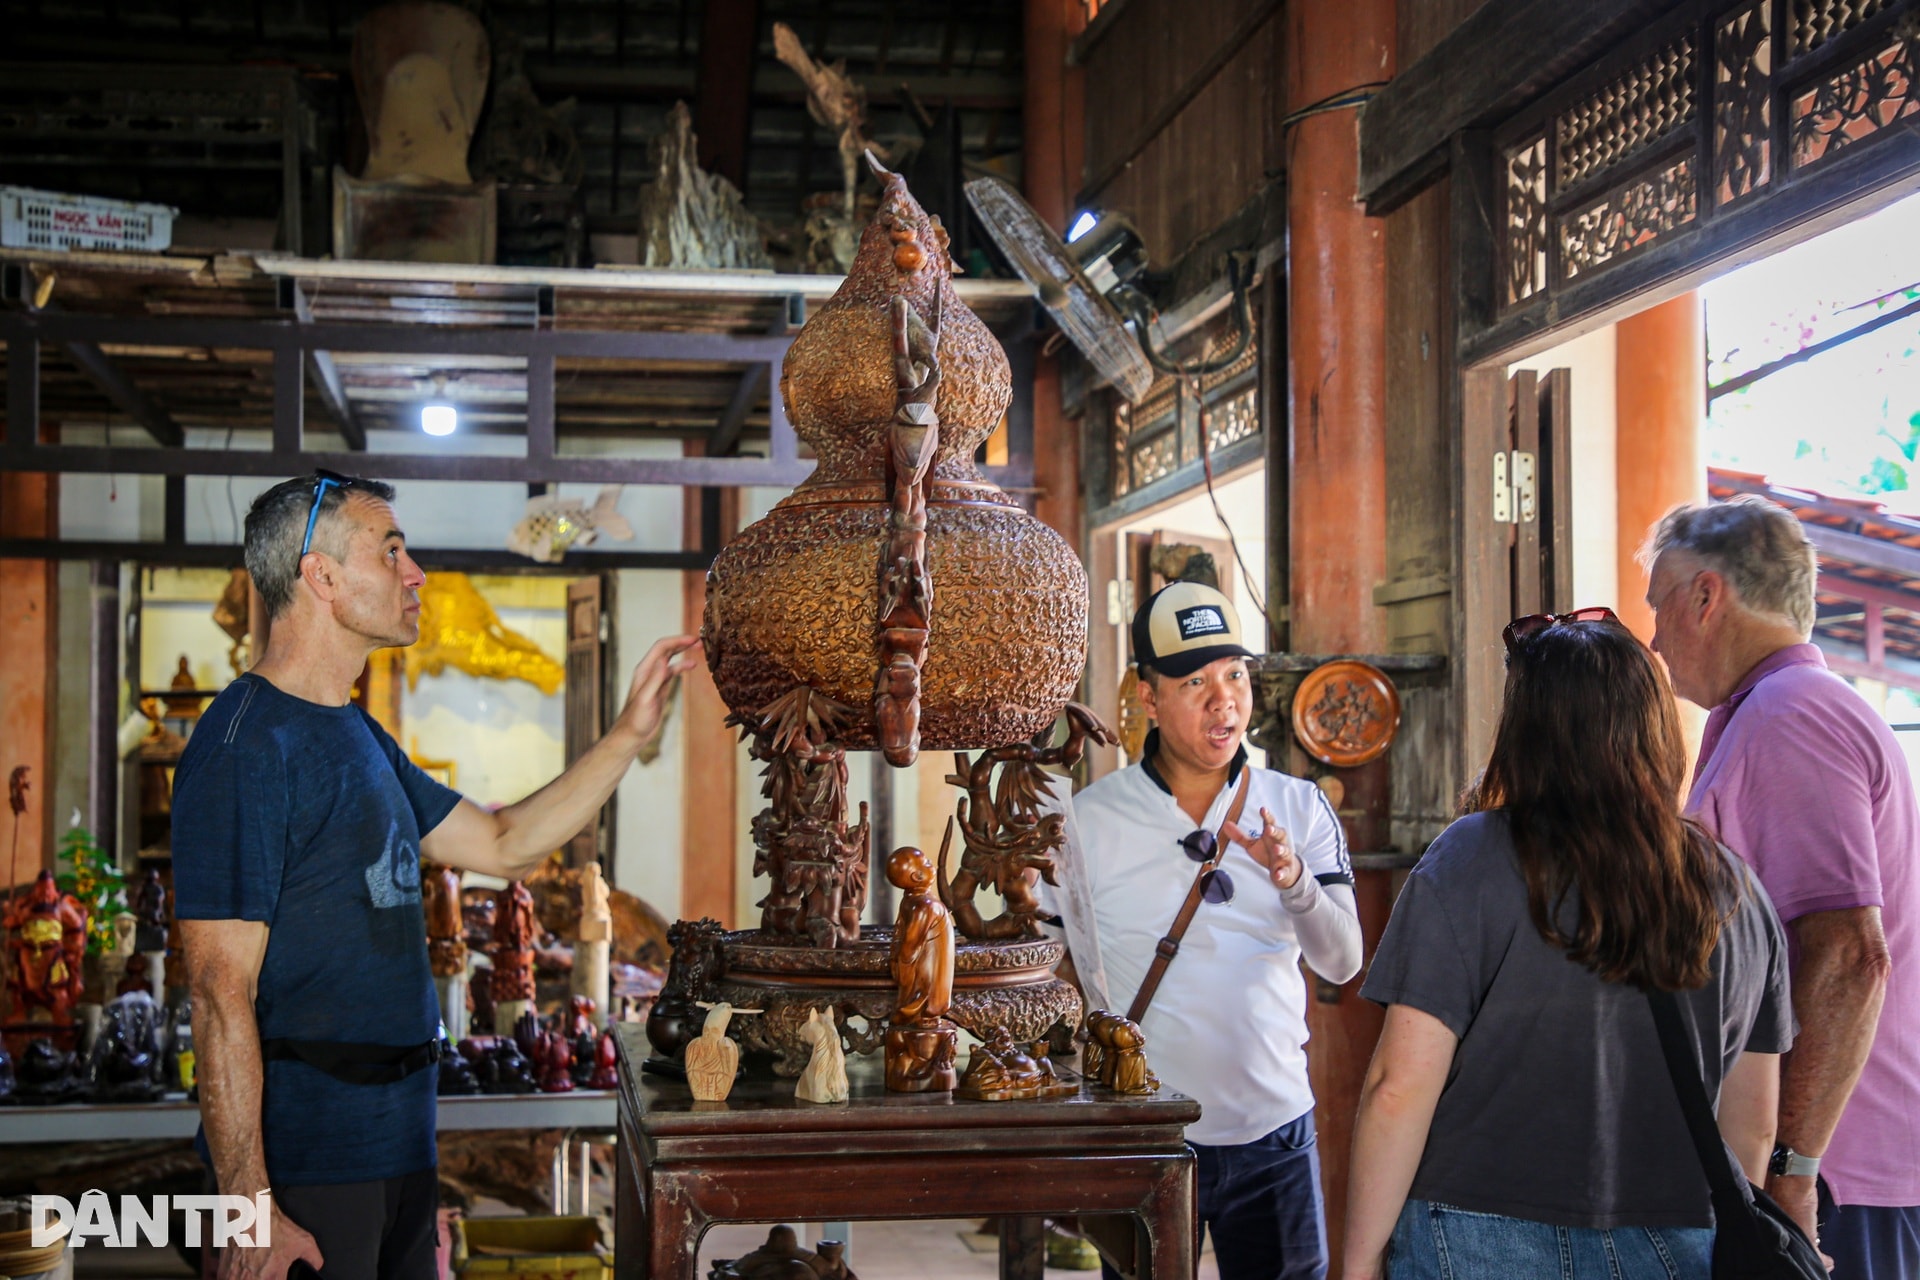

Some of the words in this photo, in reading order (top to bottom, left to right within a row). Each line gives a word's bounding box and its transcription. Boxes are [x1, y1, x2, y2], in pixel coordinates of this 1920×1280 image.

[1192, 609, 1208, 617] THE
[1182, 615, 1208, 626] NORTH
[1187, 620, 1210, 630] FACE
